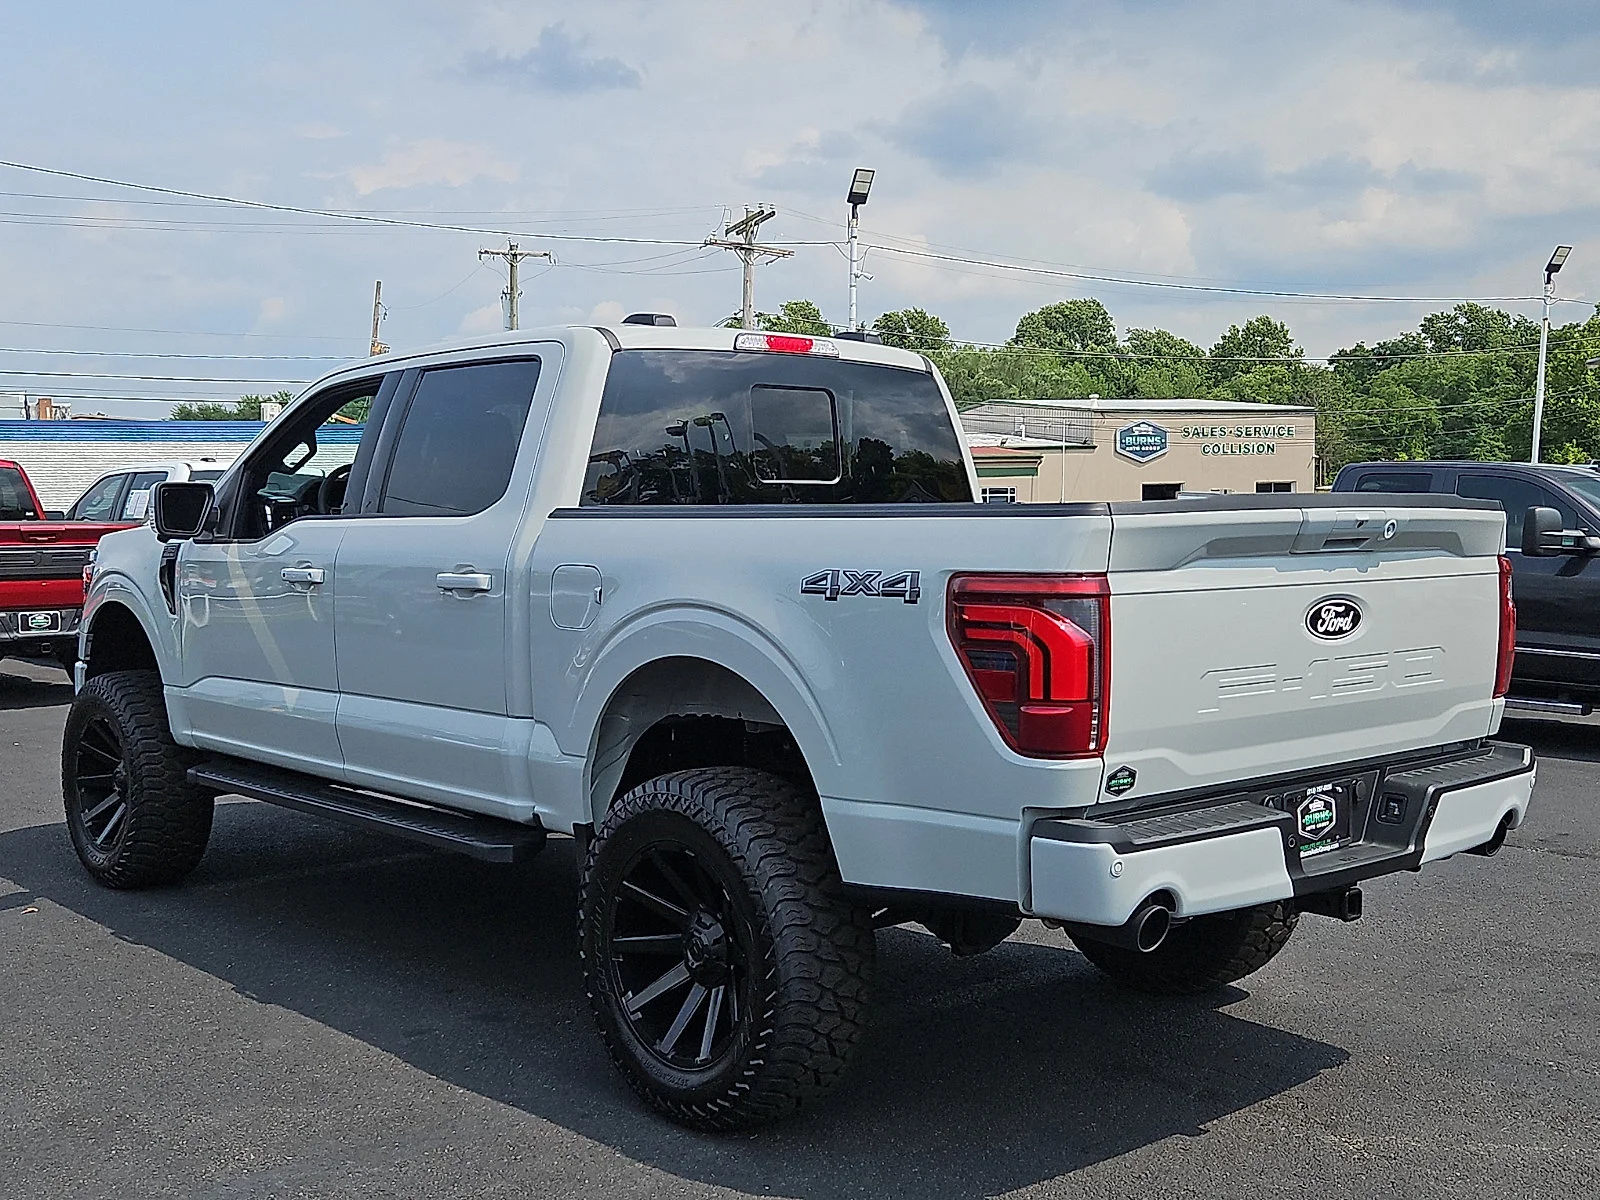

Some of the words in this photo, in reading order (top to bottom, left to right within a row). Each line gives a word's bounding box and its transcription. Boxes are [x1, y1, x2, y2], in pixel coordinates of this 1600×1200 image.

[1181, 426, 1227, 438] SALES
[1234, 425, 1296, 438] SERVICE
[1125, 436, 1162, 446] BURNS
[1201, 442, 1277, 455] COLLISION
[1317, 605, 1353, 632] Ford
[1197, 646, 1446, 713] F-150
[1305, 809, 1330, 825] BURNS
